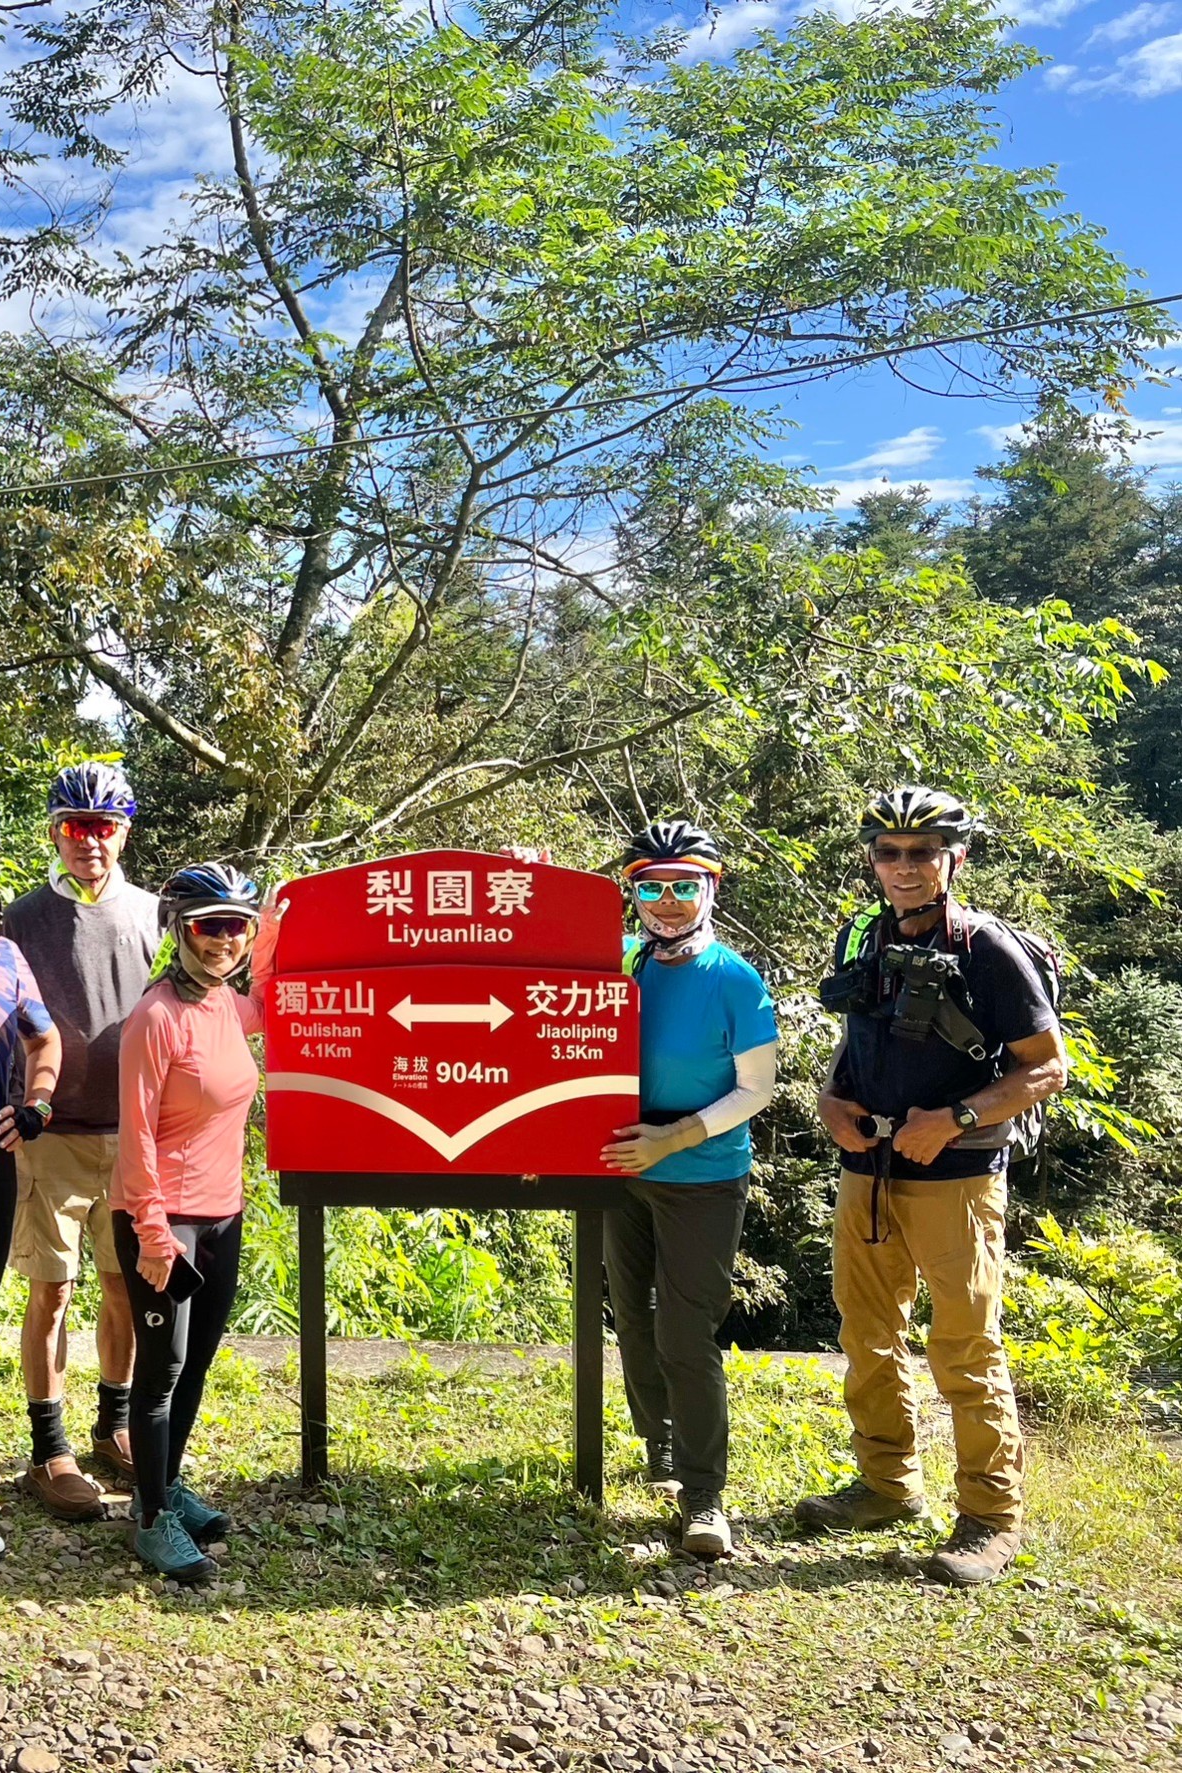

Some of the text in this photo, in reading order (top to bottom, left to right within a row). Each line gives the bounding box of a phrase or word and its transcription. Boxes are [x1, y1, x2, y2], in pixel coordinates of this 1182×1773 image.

[366, 869, 534, 917] 梨園寮
[387, 923, 514, 948] Liyuanliao
[952, 920, 963, 942] EOS
[275, 980, 375, 1017] 獨立山
[526, 981, 629, 1017] 交力坪
[290, 1022, 362, 1038] Dulishan
[536, 1023, 618, 1043] Jiaoliping
[300, 1043, 352, 1058] 4.1Km
[551, 1045, 604, 1060] 3.5Km
[393, 1056, 429, 1072] 海拔
[435, 1061, 509, 1083] 904m
[392, 1073, 428, 1081] Elevation
